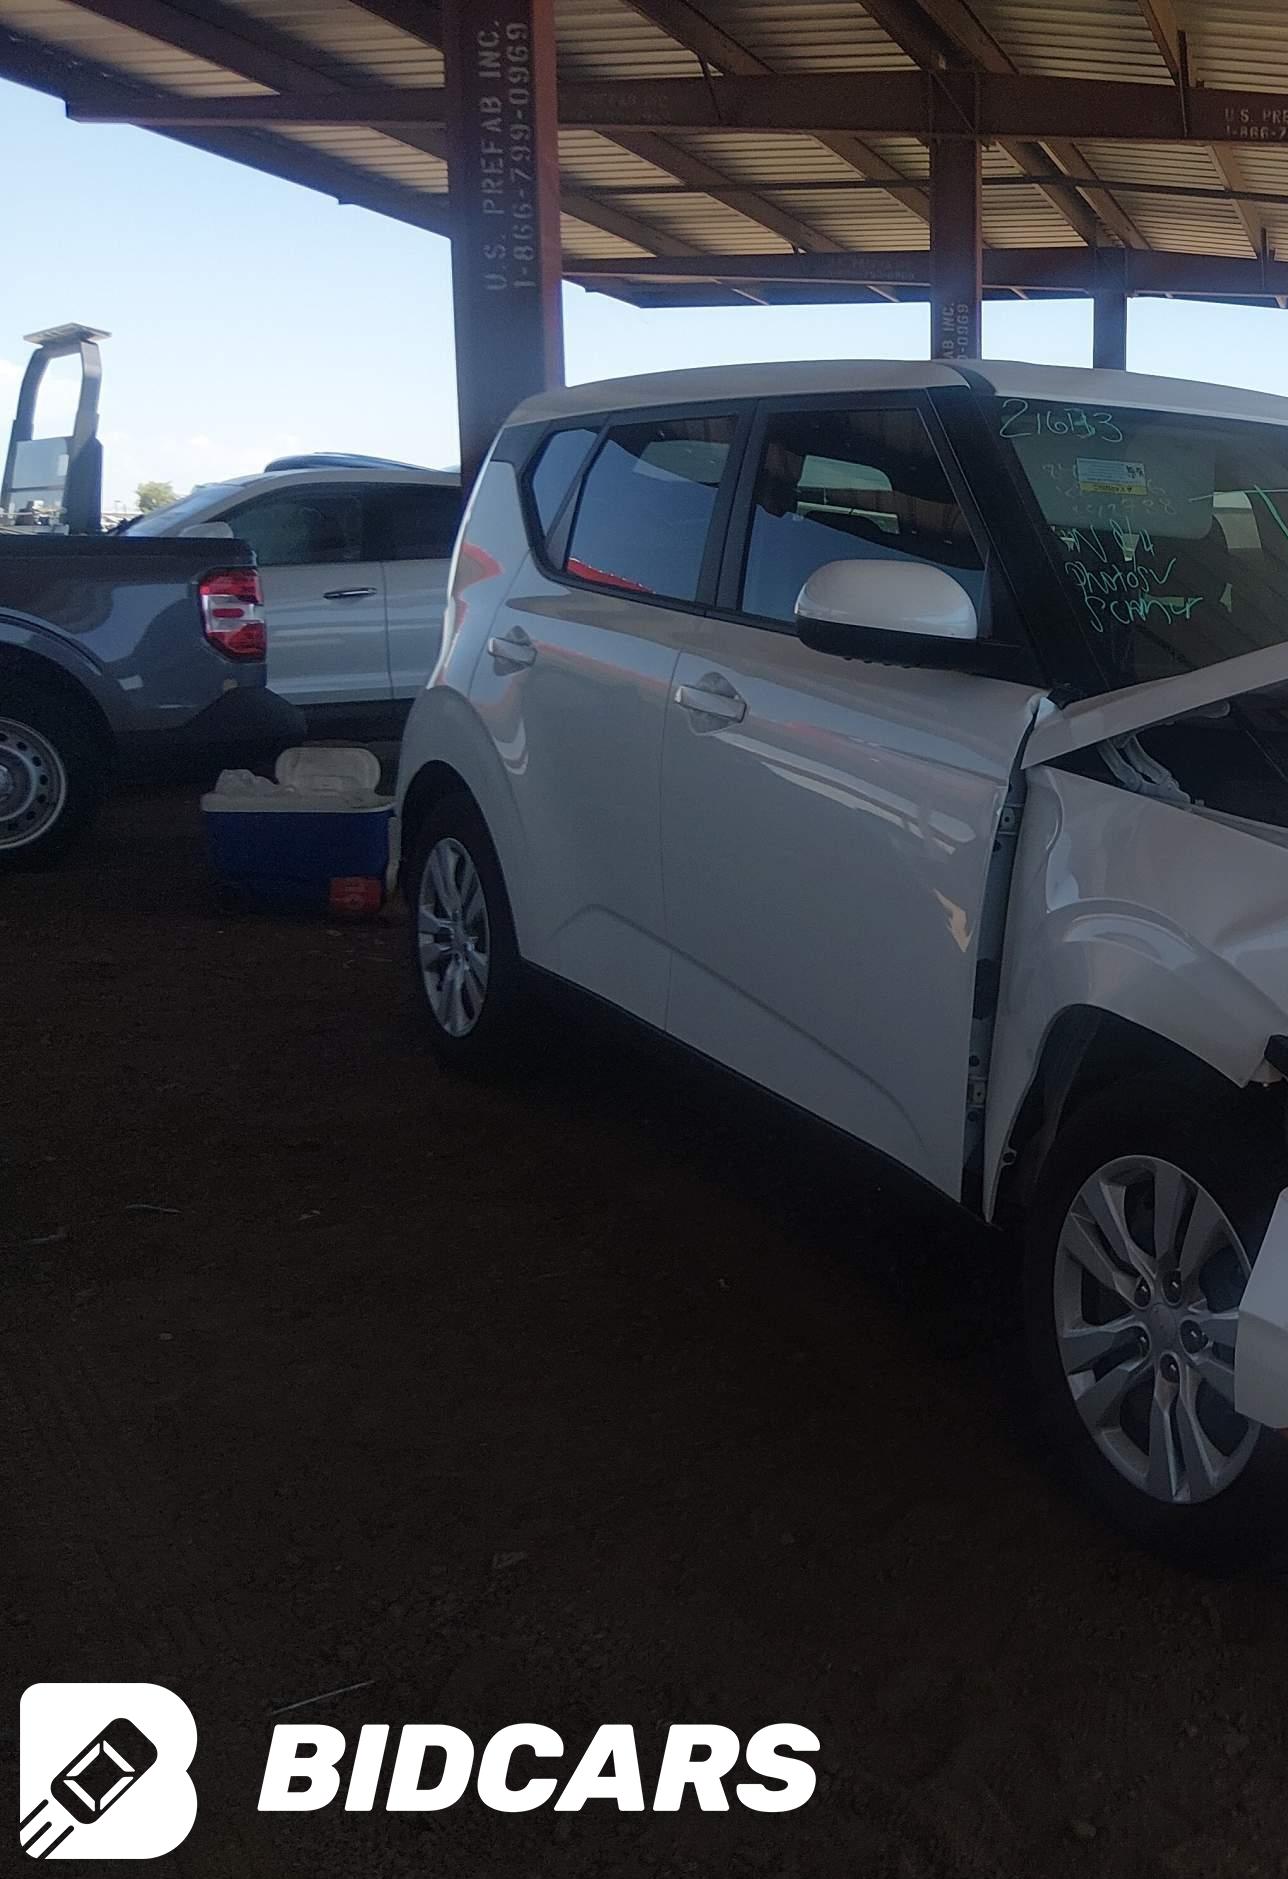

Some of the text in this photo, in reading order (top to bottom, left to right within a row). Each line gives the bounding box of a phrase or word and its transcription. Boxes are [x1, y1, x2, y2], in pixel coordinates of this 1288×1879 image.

[477, 21, 508, 291] U.S. PREFAB INC.
[506, 23, 537, 288] 1-866-799-0969
